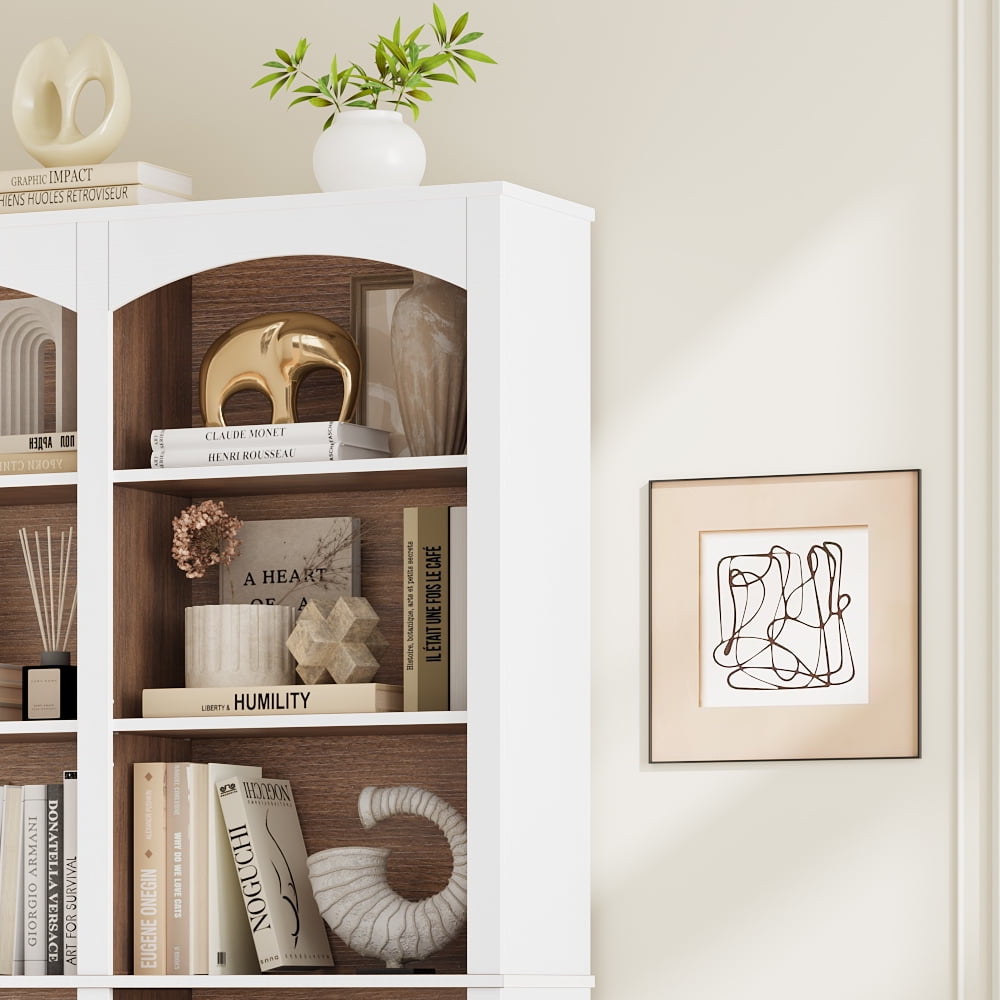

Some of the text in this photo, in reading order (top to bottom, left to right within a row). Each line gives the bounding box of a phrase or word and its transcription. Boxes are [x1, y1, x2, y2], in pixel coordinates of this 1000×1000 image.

[11, 168, 93, 187] GRAPHIC IMPACT
[28, 190, 64, 205] HUOLES
[66, 186, 128, 202] RETROVISEUR
[205, 427, 286, 441] CLAUDE MONET
[208, 449, 296, 462] HENRI ROUSSEAU
[243, 568, 326, 586] A HEART
[423, 546, 442, 662] IL ÉTAIT UNE FOIS LE CAFÉ
[234, 692, 311, 711] HUMILITY
[243, 781, 290, 801] NOGUCHI
[28, 817, 38, 947] GIORGIO ARMANI
[49, 800, 58, 962] DONATELLA VERSACE
[174, 832, 182, 919] WHY DO WE LOVE CATS
[229, 824, 271, 933] NOGUCHI
[66, 856, 77, 966] ART FOR SURVIVAL
[140, 869, 157, 968] EUGENE ONEGIN
